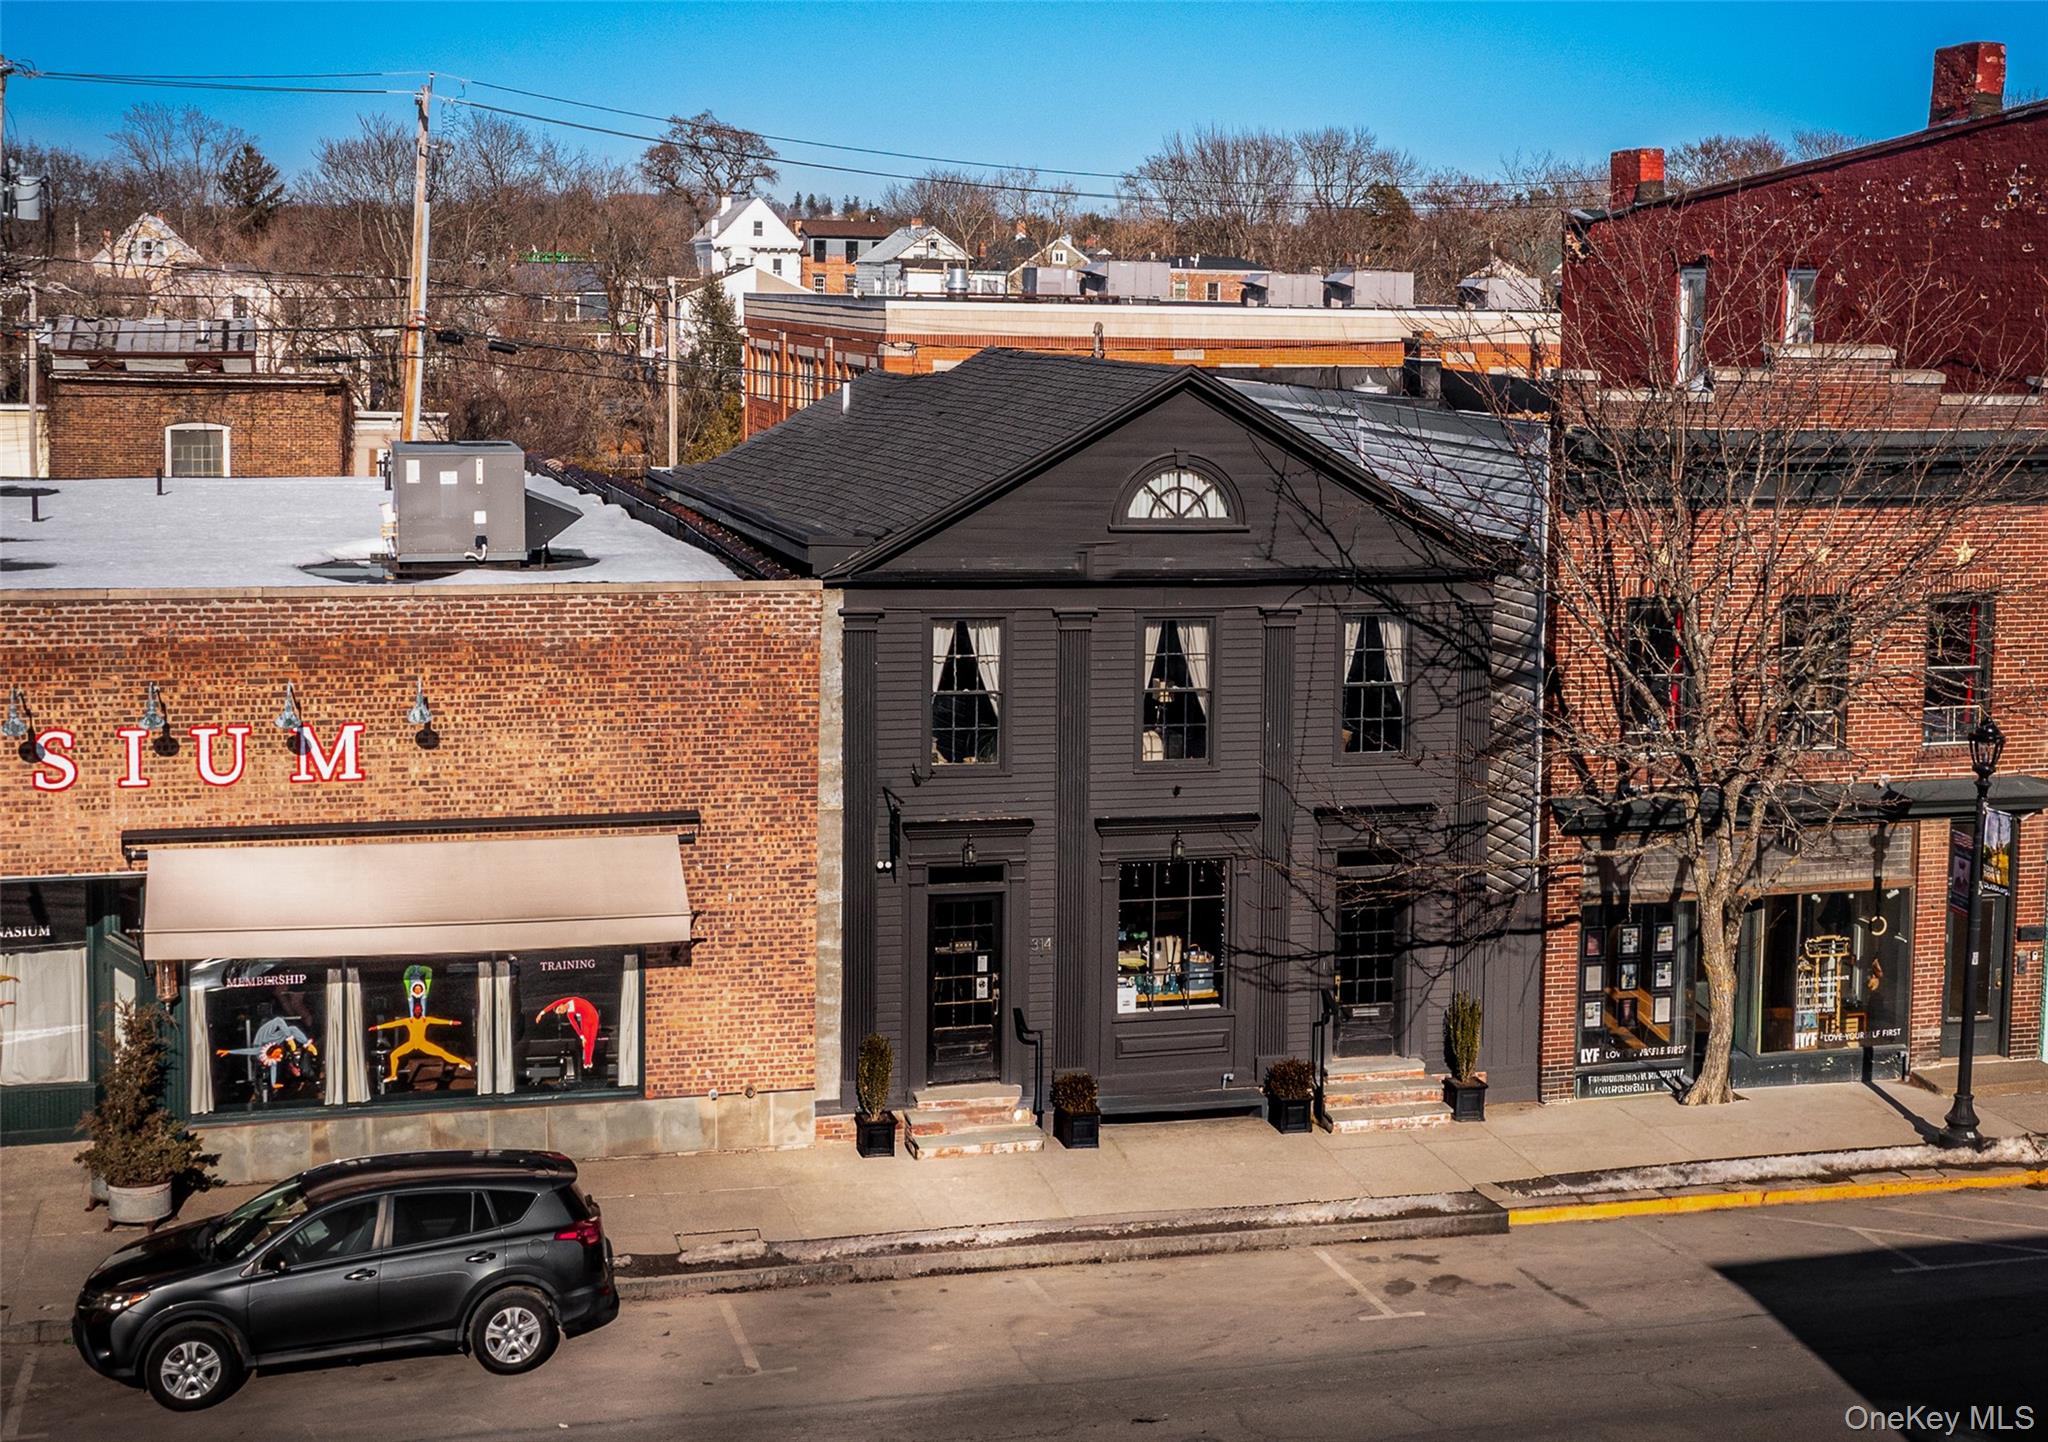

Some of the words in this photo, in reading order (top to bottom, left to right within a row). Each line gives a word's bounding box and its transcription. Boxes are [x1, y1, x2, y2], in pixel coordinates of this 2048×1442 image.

[1031, 937, 1051, 951] 314
[540, 959, 596, 971] TRAINING
[226, 974, 307, 987] MEMBERSHIP
[1845, 1029, 1880, 1041] YOURLF
[1882, 1028, 1901, 1037] FIRST
[1581, 1047, 1600, 1064] LYF
